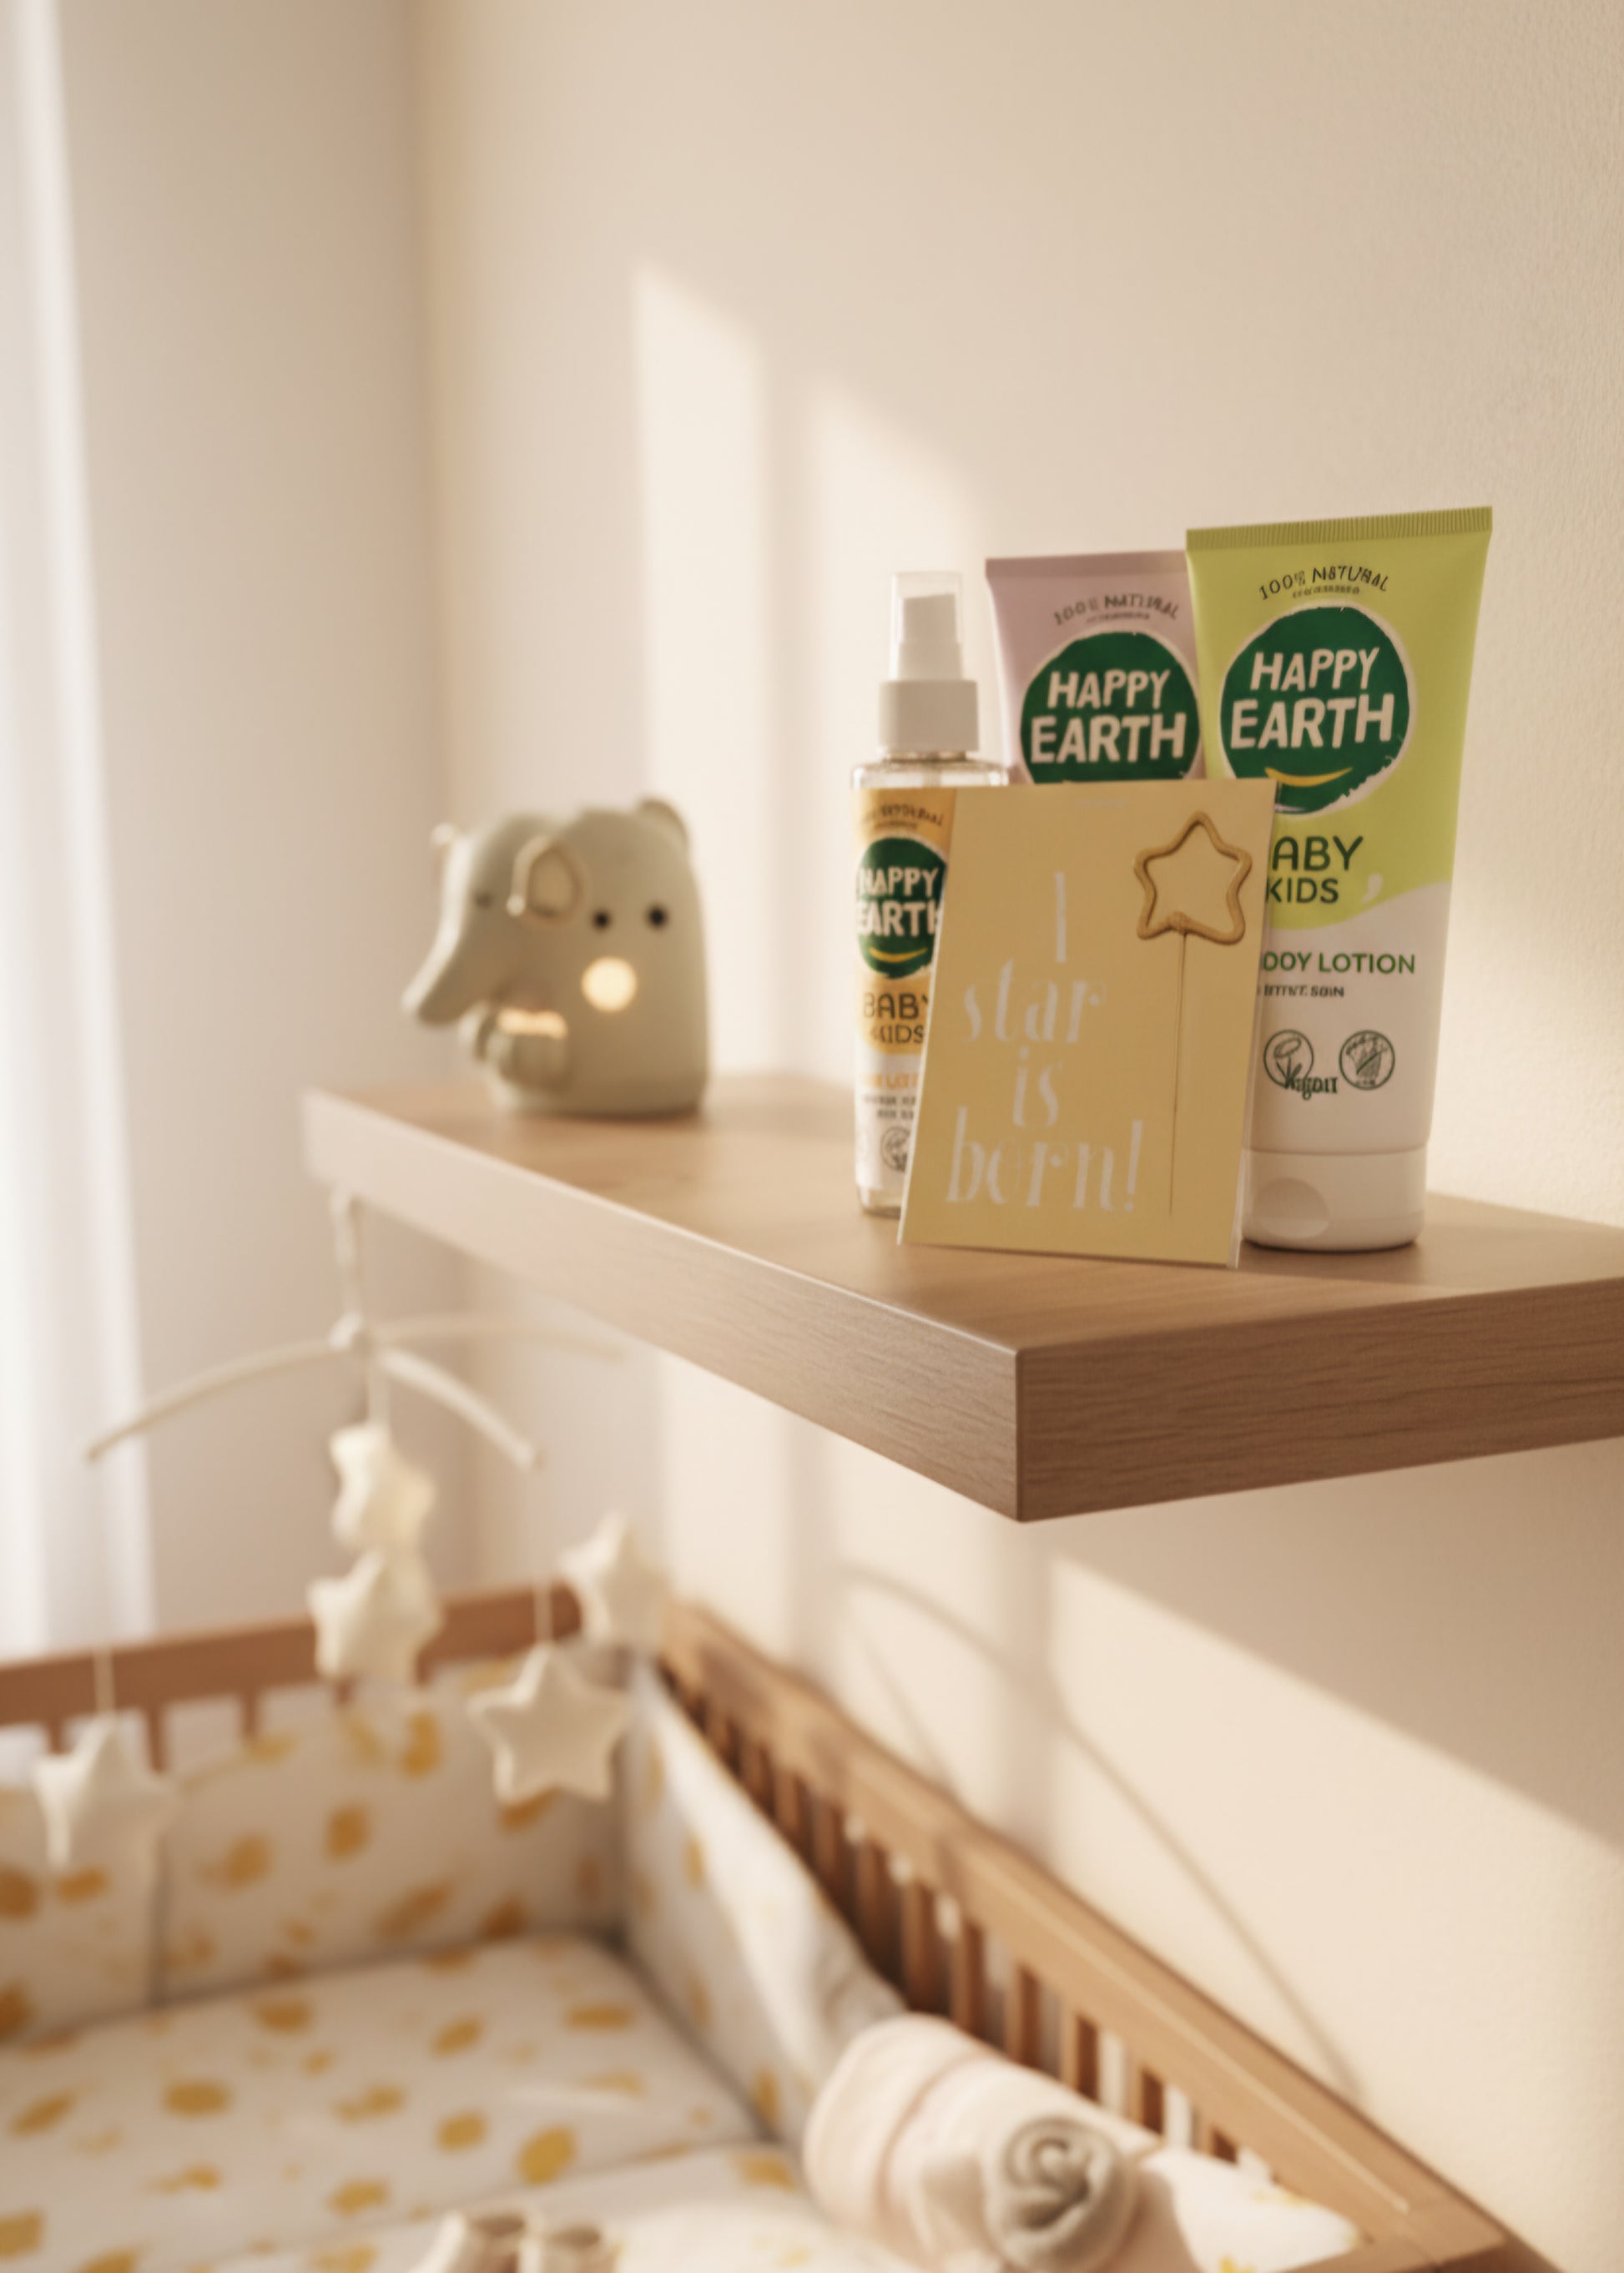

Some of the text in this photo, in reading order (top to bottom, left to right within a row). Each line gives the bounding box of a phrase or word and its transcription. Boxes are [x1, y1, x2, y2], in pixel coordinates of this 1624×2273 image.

[1047, 669, 1170, 709] HAPPY
[1250, 647, 1379, 692] HAPPY
[1031, 713, 1186, 764] EARTH
[1230, 693, 1395, 749] EARTH
[1271, 835, 1364, 871] ABY
[858, 867, 939, 897] HAPPY
[1265, 878, 1339, 904] KIDS
[1319, 952, 1416, 975] LOTION
[863, 992, 929, 1021] BAB
[962, 957, 1107, 1043] star
[1012, 1045, 1065, 1128] is
[945, 1105, 1144, 1212] born!
